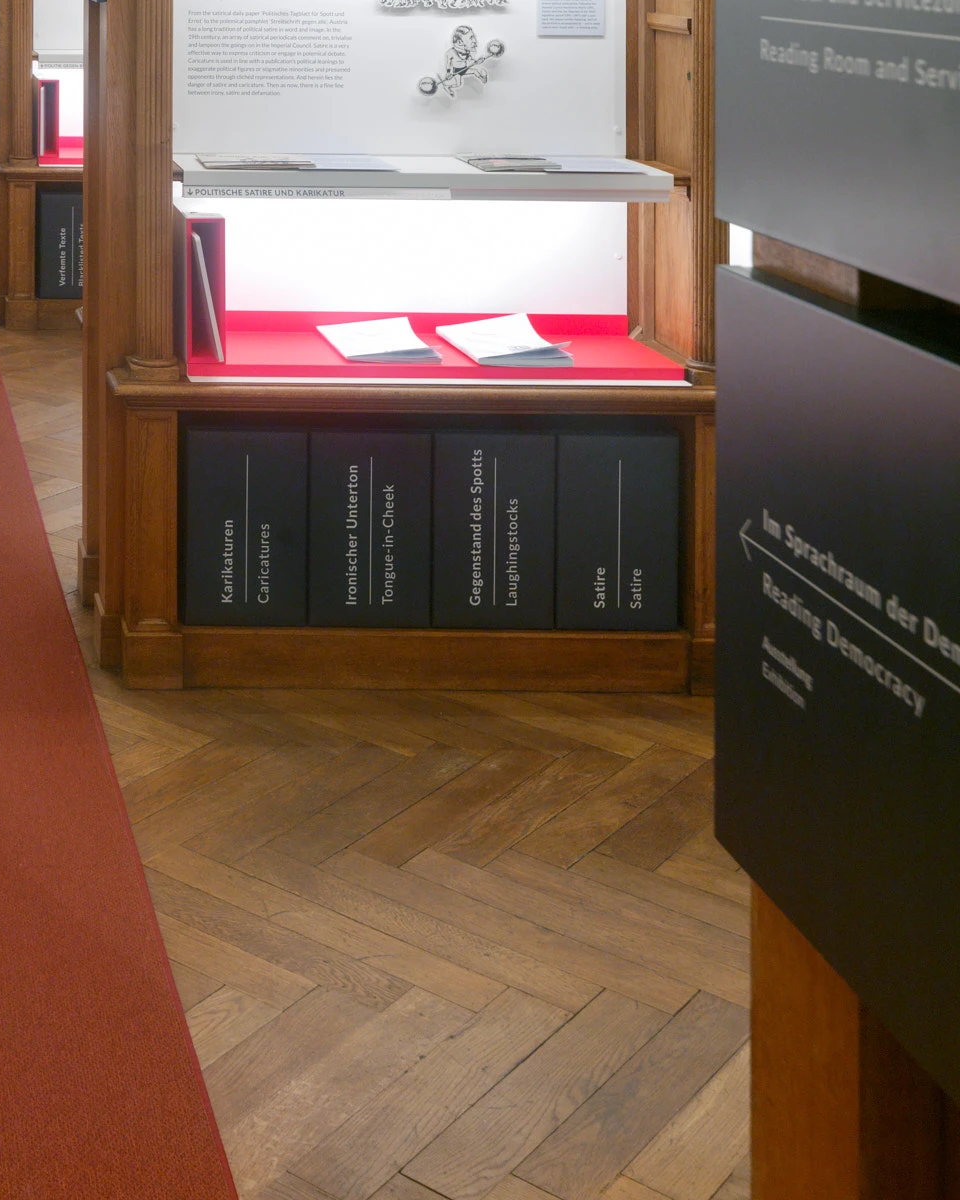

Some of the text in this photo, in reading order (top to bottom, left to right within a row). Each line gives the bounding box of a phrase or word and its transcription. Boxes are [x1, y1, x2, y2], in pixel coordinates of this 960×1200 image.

[760, 37, 819, 75] Reading
[823, 46, 871, 78] Room
[876, 53, 909, 83] and
[195, 188, 242, 196] POLITISCHE
[274, 189, 294, 197] UND
[296, 189, 345, 197] KARIKATUR
[221, 519, 234, 603] Karikaturen
[257, 523, 270, 604] Caricatures
[346, 465, 358, 605] Ironischer Unterton
[382, 484, 395, 605] Tongue-in-Cheek
[470, 448, 484, 606] Gegenstand des Spotts
[506, 498, 520, 607] Laughingstocks
[762, 507, 782, 541] Im
[784, 524, 882, 611] Sprachraum
[886, 594, 919, 636] der
[594, 566, 606, 609] Satire
[630, 568, 642, 610] Satire
[762, 571, 822, 642] Reading
[826, 618, 926, 719] Democracy
